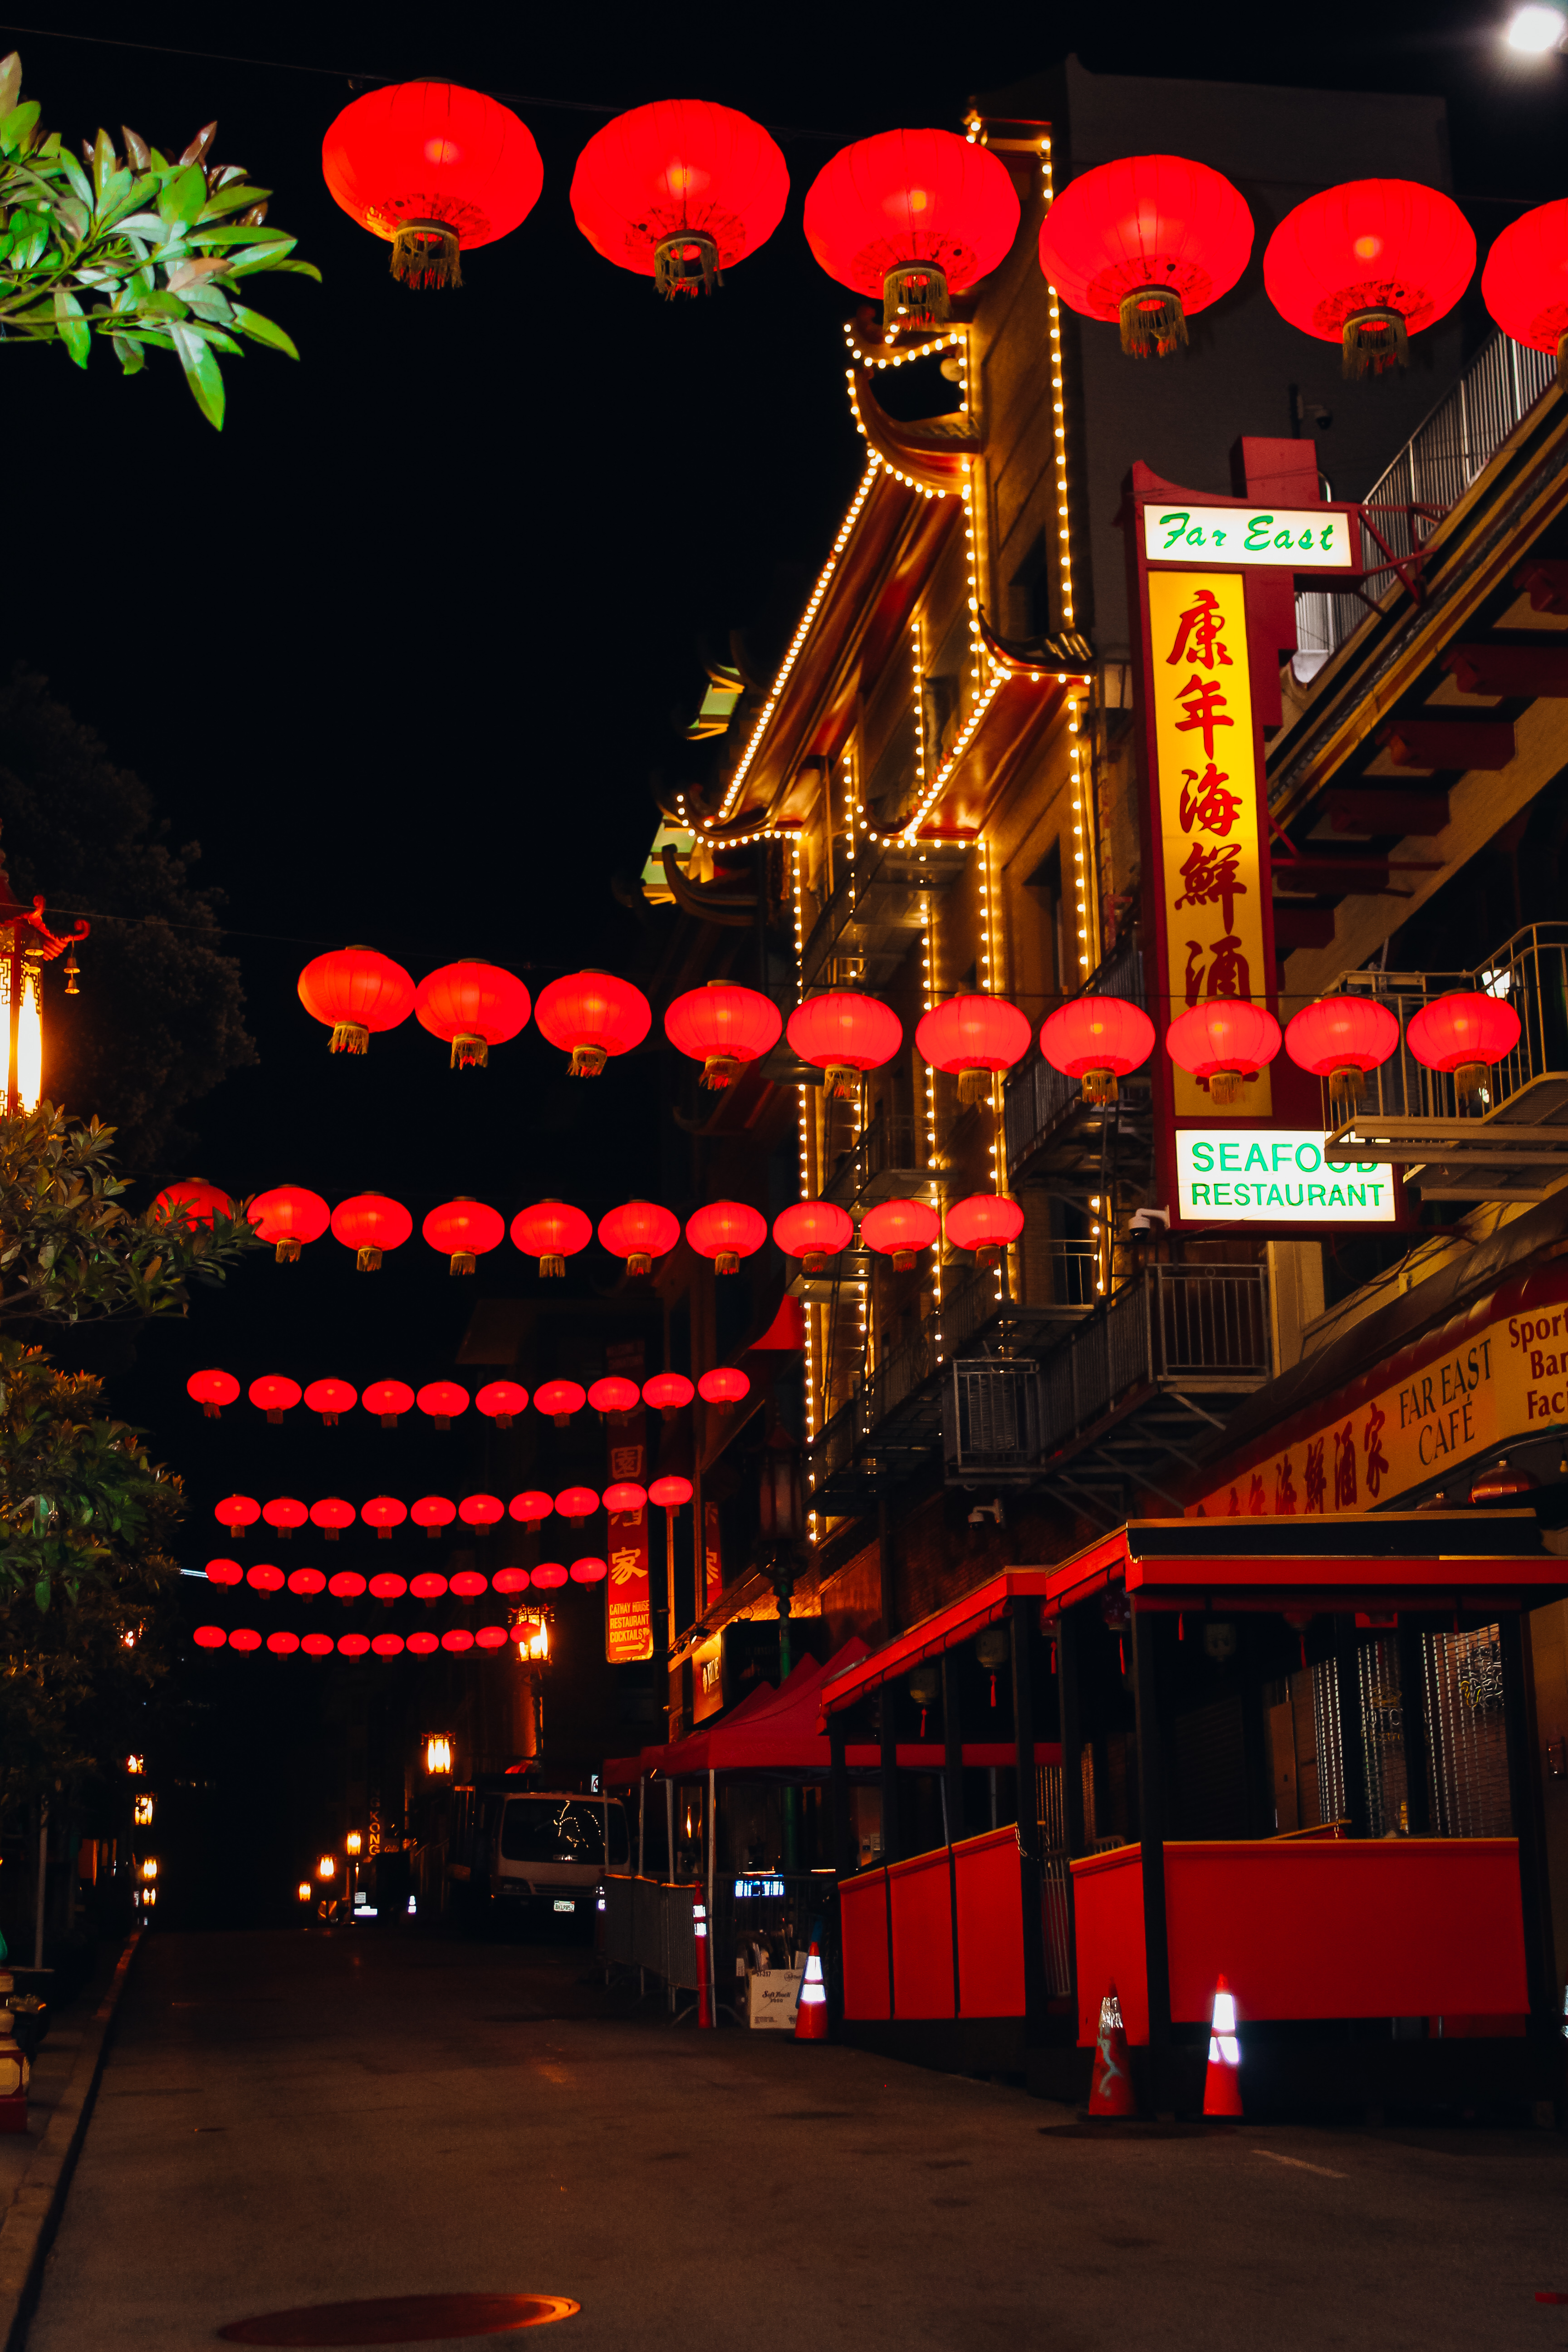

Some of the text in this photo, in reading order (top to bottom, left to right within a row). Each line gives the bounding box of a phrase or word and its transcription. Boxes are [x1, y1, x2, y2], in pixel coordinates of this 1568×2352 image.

[1160, 512, 1333, 551] Far East
[1166, 589, 1260, 1093] 康年海鮮酒
[1191, 1182, 1385, 1207] RESTAURANT
[1399, 1338, 1491, 1430] FAR EAST
[1419, 1393, 1475, 1466] CAFÉ
[609, 1600, 650, 1616] CATHAY HOUSE
[610, 1613, 649, 1629] RESTAURANT
[610, 1628, 643, 1643] COCKTAILS
[369, 1811, 380, 1855] KONG
[762, 1990, 775, 1999] Soft
